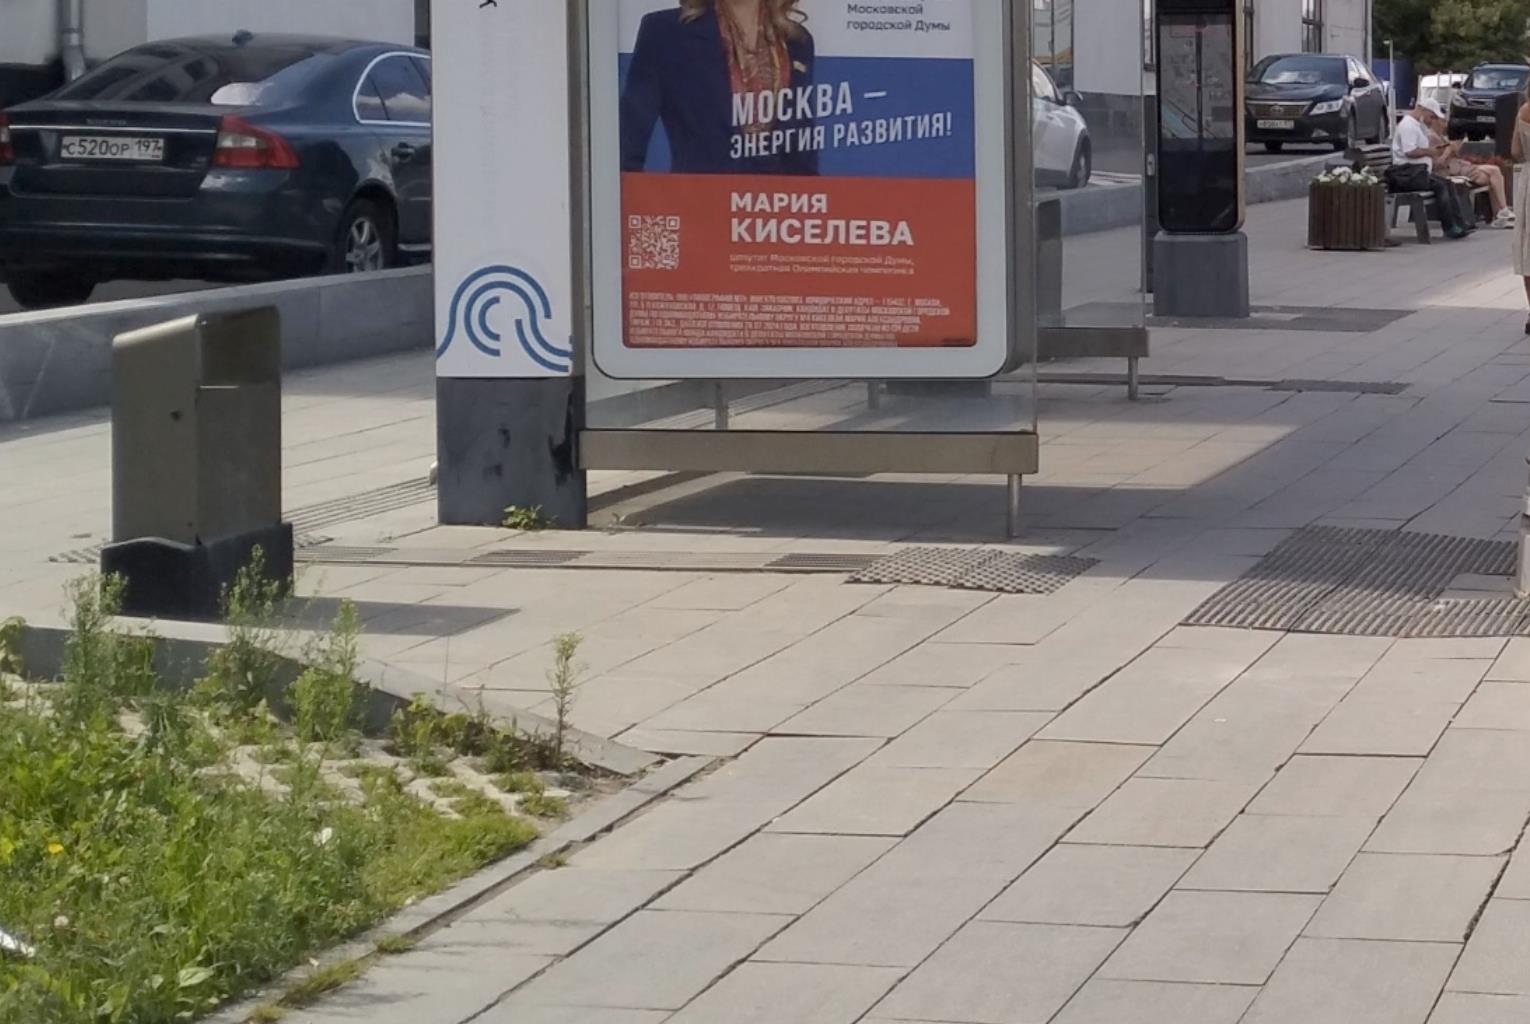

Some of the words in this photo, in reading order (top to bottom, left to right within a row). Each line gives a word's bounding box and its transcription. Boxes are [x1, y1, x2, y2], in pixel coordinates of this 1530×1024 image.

[847, 3, 923, 15] Московской
[847, 19, 912, 32] городской
[914, 19, 950, 32] Думы
[731, 81, 853, 127] МОСКВА
[730, 127, 825, 159] ЭНЕРГИЯ
[833, 111, 952, 149] РАЗВИТИЯ!
[730, 192, 828, 213] МАРИЯ
[730, 218, 914, 246] КИСЕЛЕВА
